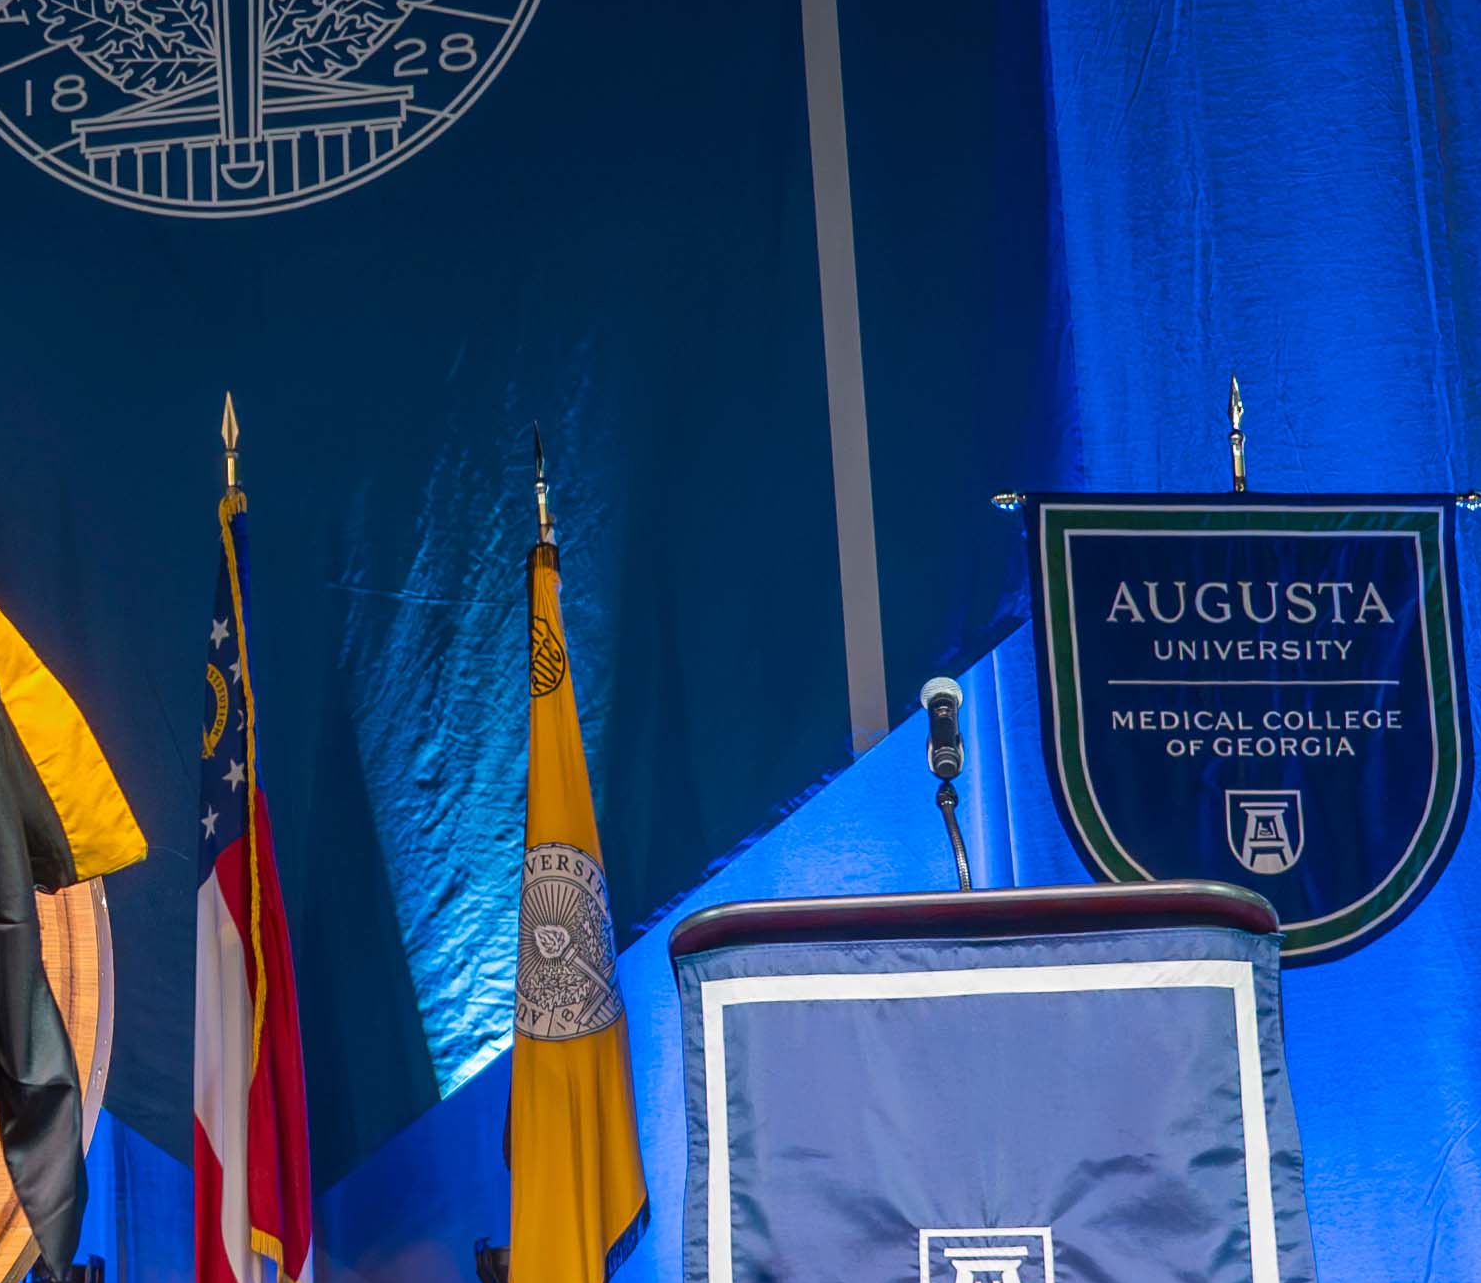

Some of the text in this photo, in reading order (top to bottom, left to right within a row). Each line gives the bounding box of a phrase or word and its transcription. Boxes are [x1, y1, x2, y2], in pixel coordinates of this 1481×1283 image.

[24, 32, 477, 116] 18 28
[1106, 581, 1395, 624] AUGUSTA
[1153, 640, 1353, 661] UNIVERSITY
[1112, 709, 1403, 731] MEDICAL COLLEGE
[1166, 737, 1356, 758] OF GEORGIA
